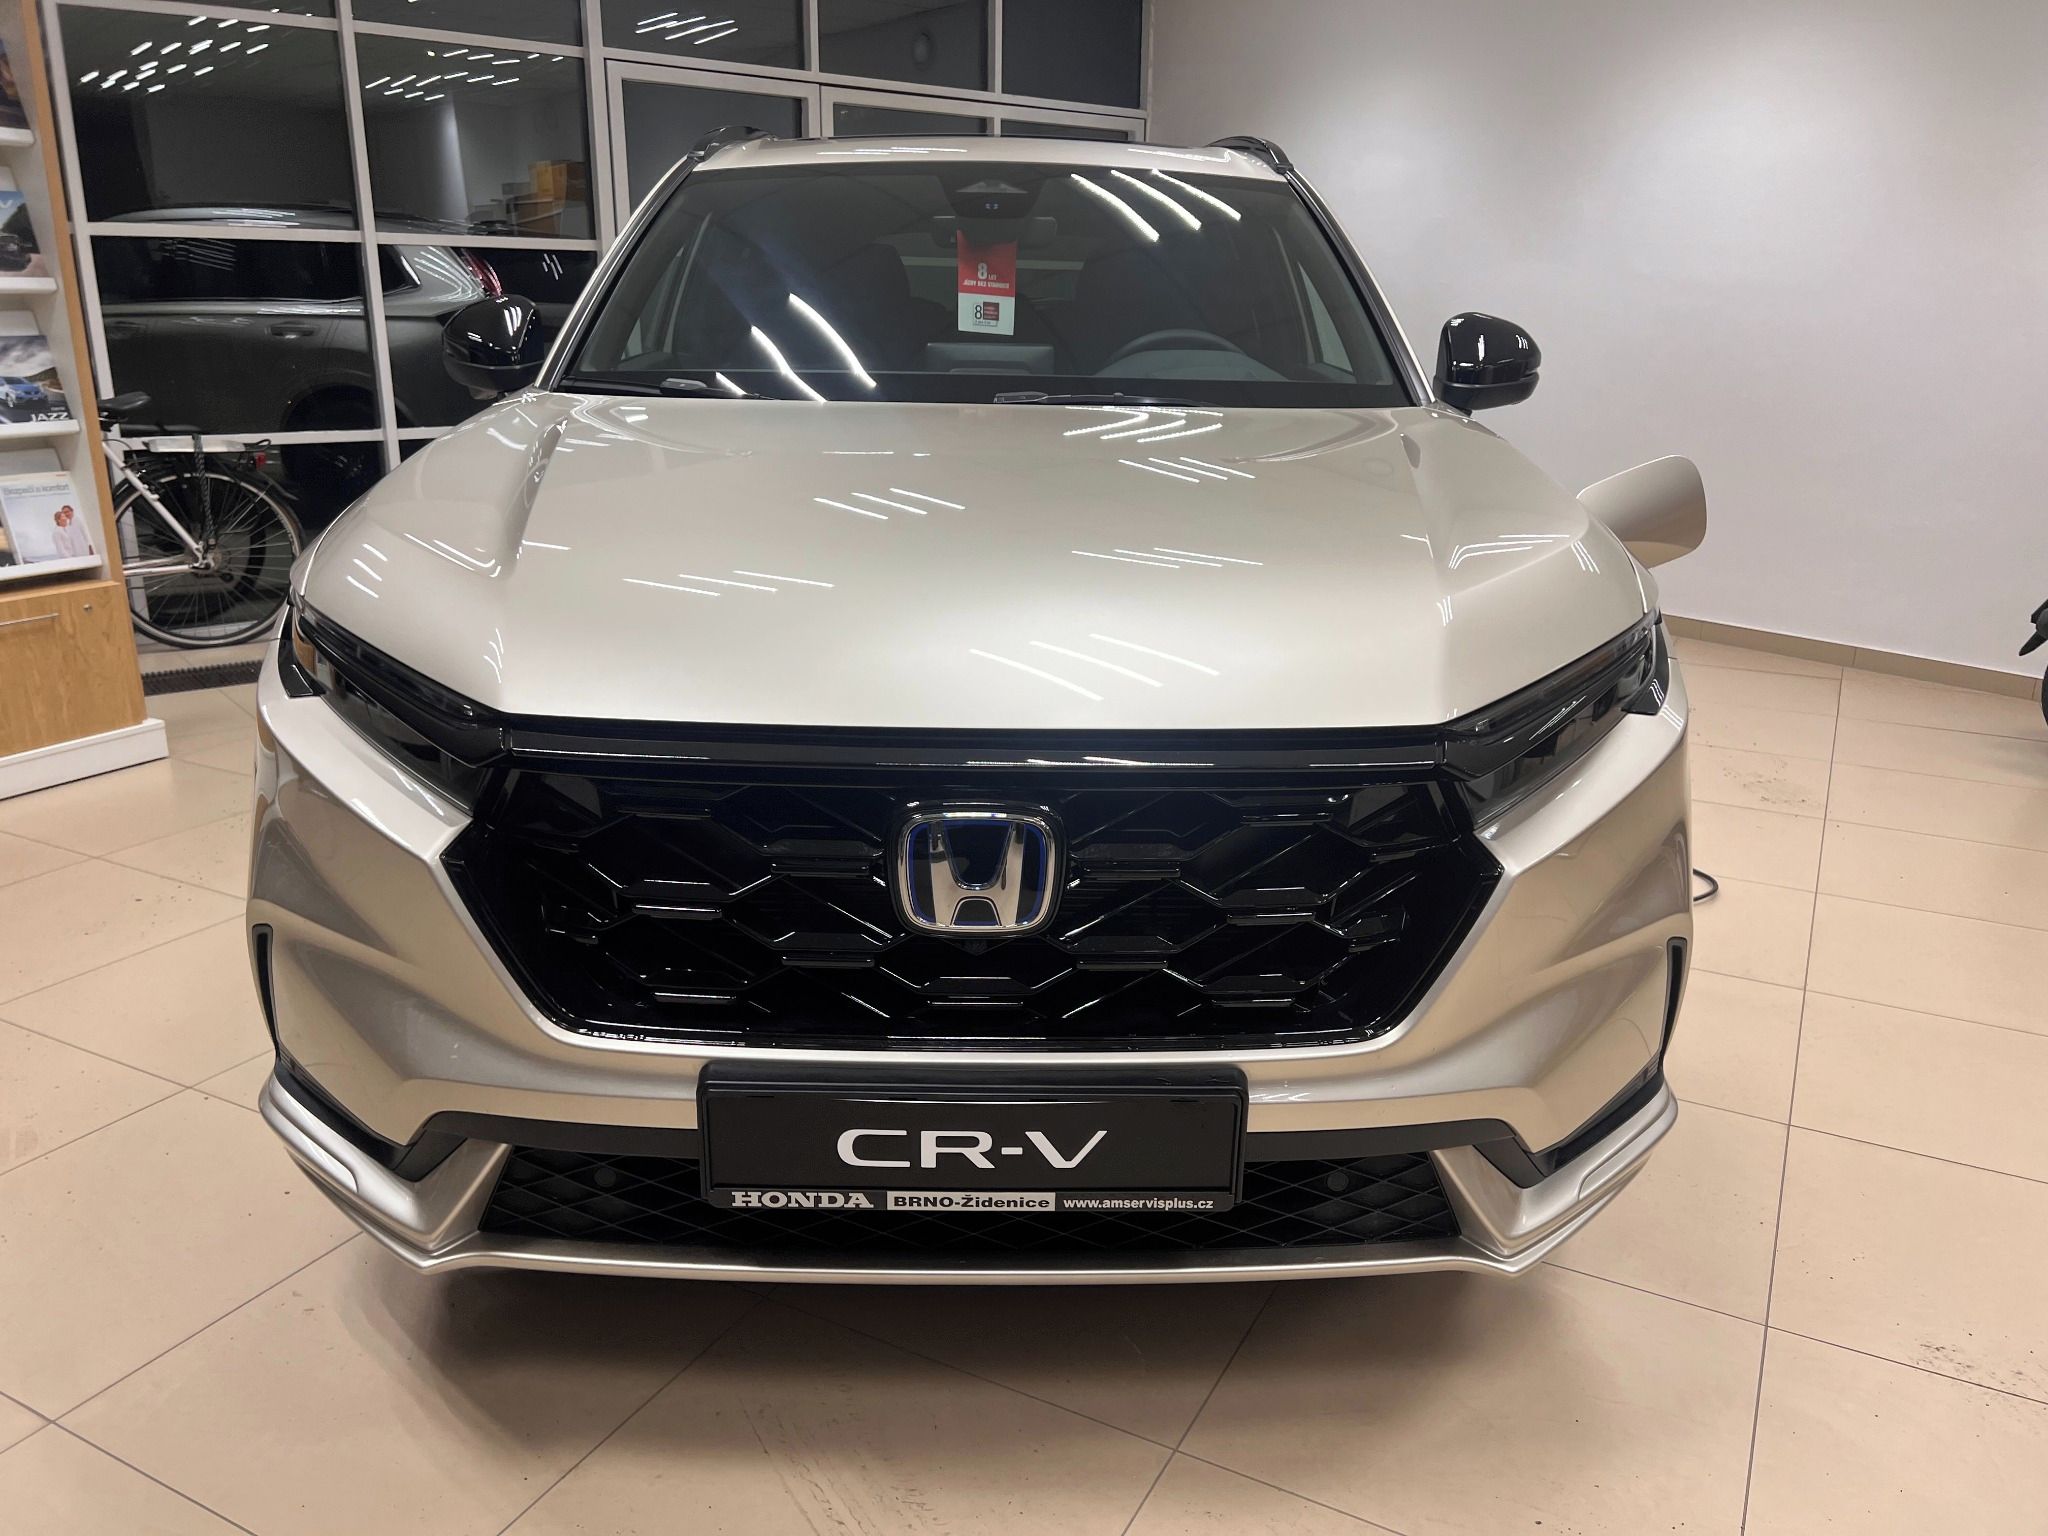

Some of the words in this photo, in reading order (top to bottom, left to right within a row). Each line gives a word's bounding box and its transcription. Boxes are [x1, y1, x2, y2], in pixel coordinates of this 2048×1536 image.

[978, 262, 987, 279] 8
[975, 305, 982, 319] 8
[31, 412, 69, 422] JAZZ
[836, 1128, 1108, 1168] CR-V
[731, 1191, 874, 1209] HONDA
[893, 1194, 1050, 1208] BRNO-Židenice
[1063, 1196, 1214, 1211] www.amservisplus.cz
